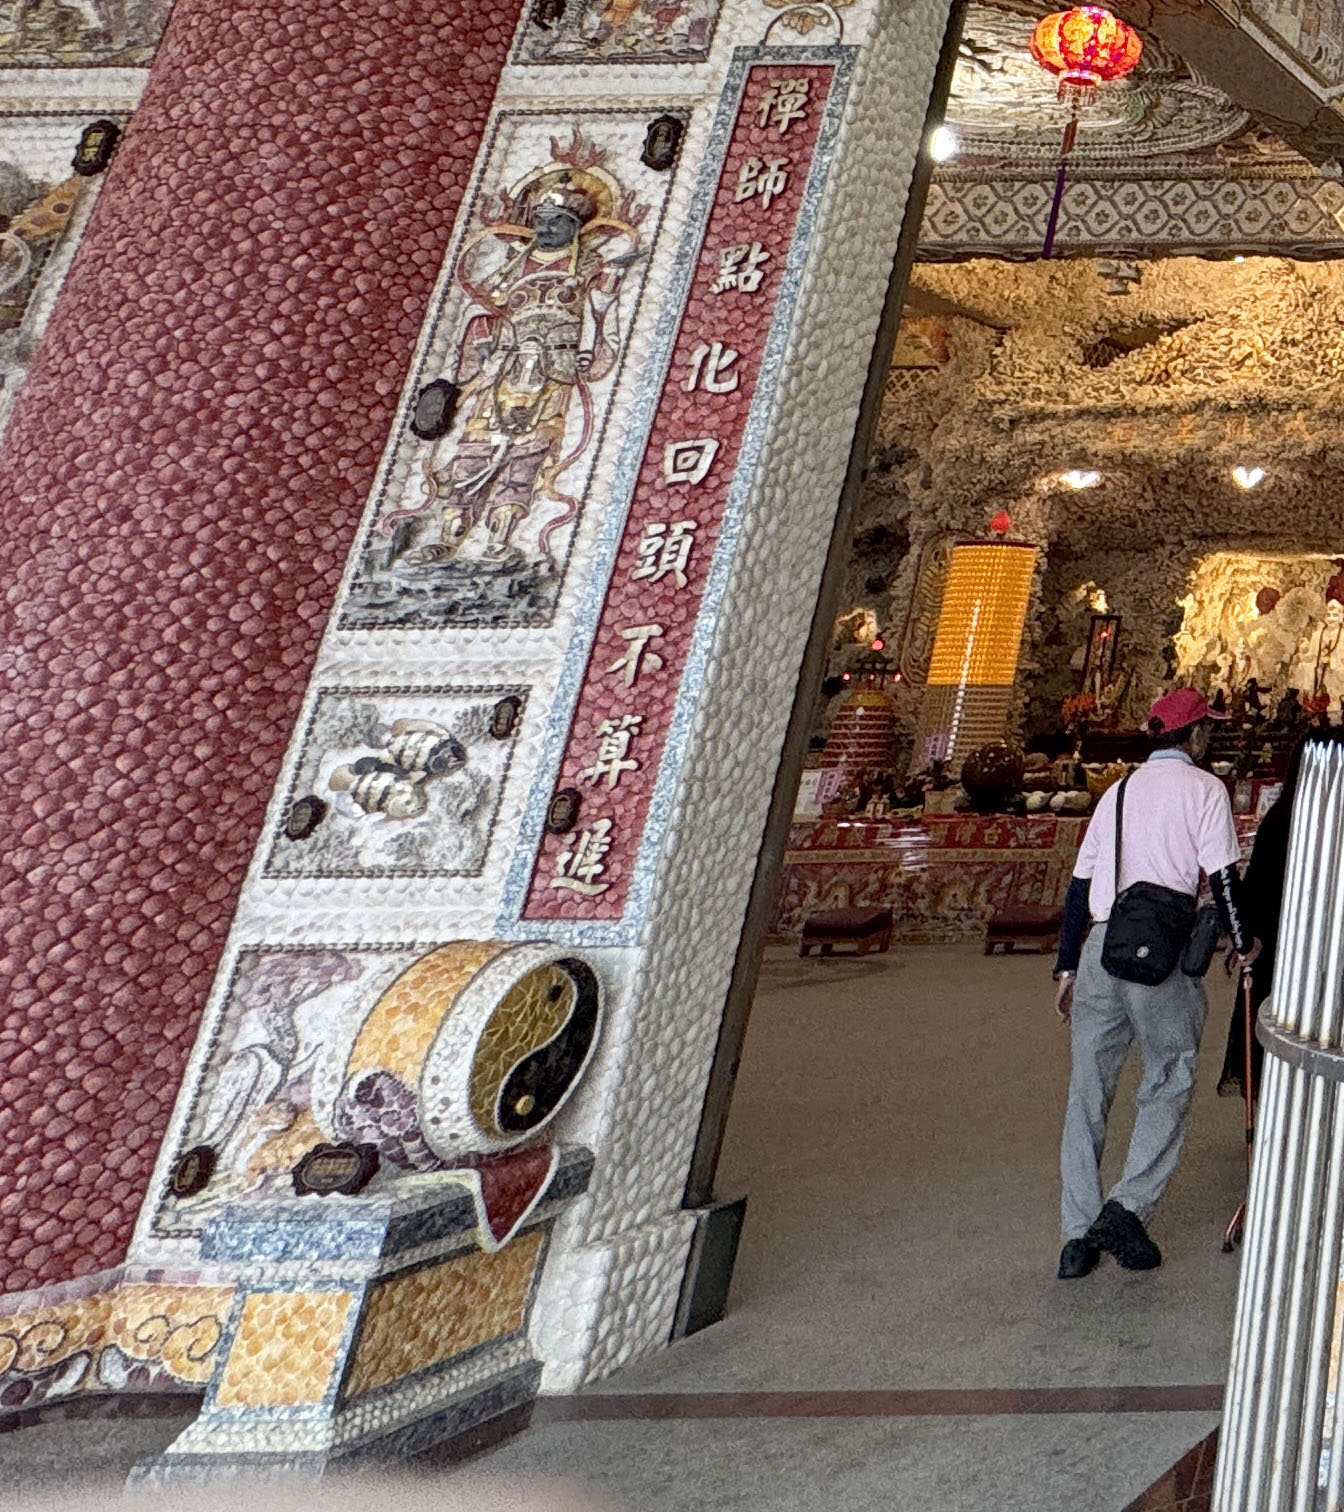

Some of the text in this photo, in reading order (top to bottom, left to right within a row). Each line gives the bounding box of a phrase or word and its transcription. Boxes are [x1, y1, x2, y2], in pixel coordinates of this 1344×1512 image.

[550, 77, 810, 896] 禪師點化回頭不算遲
